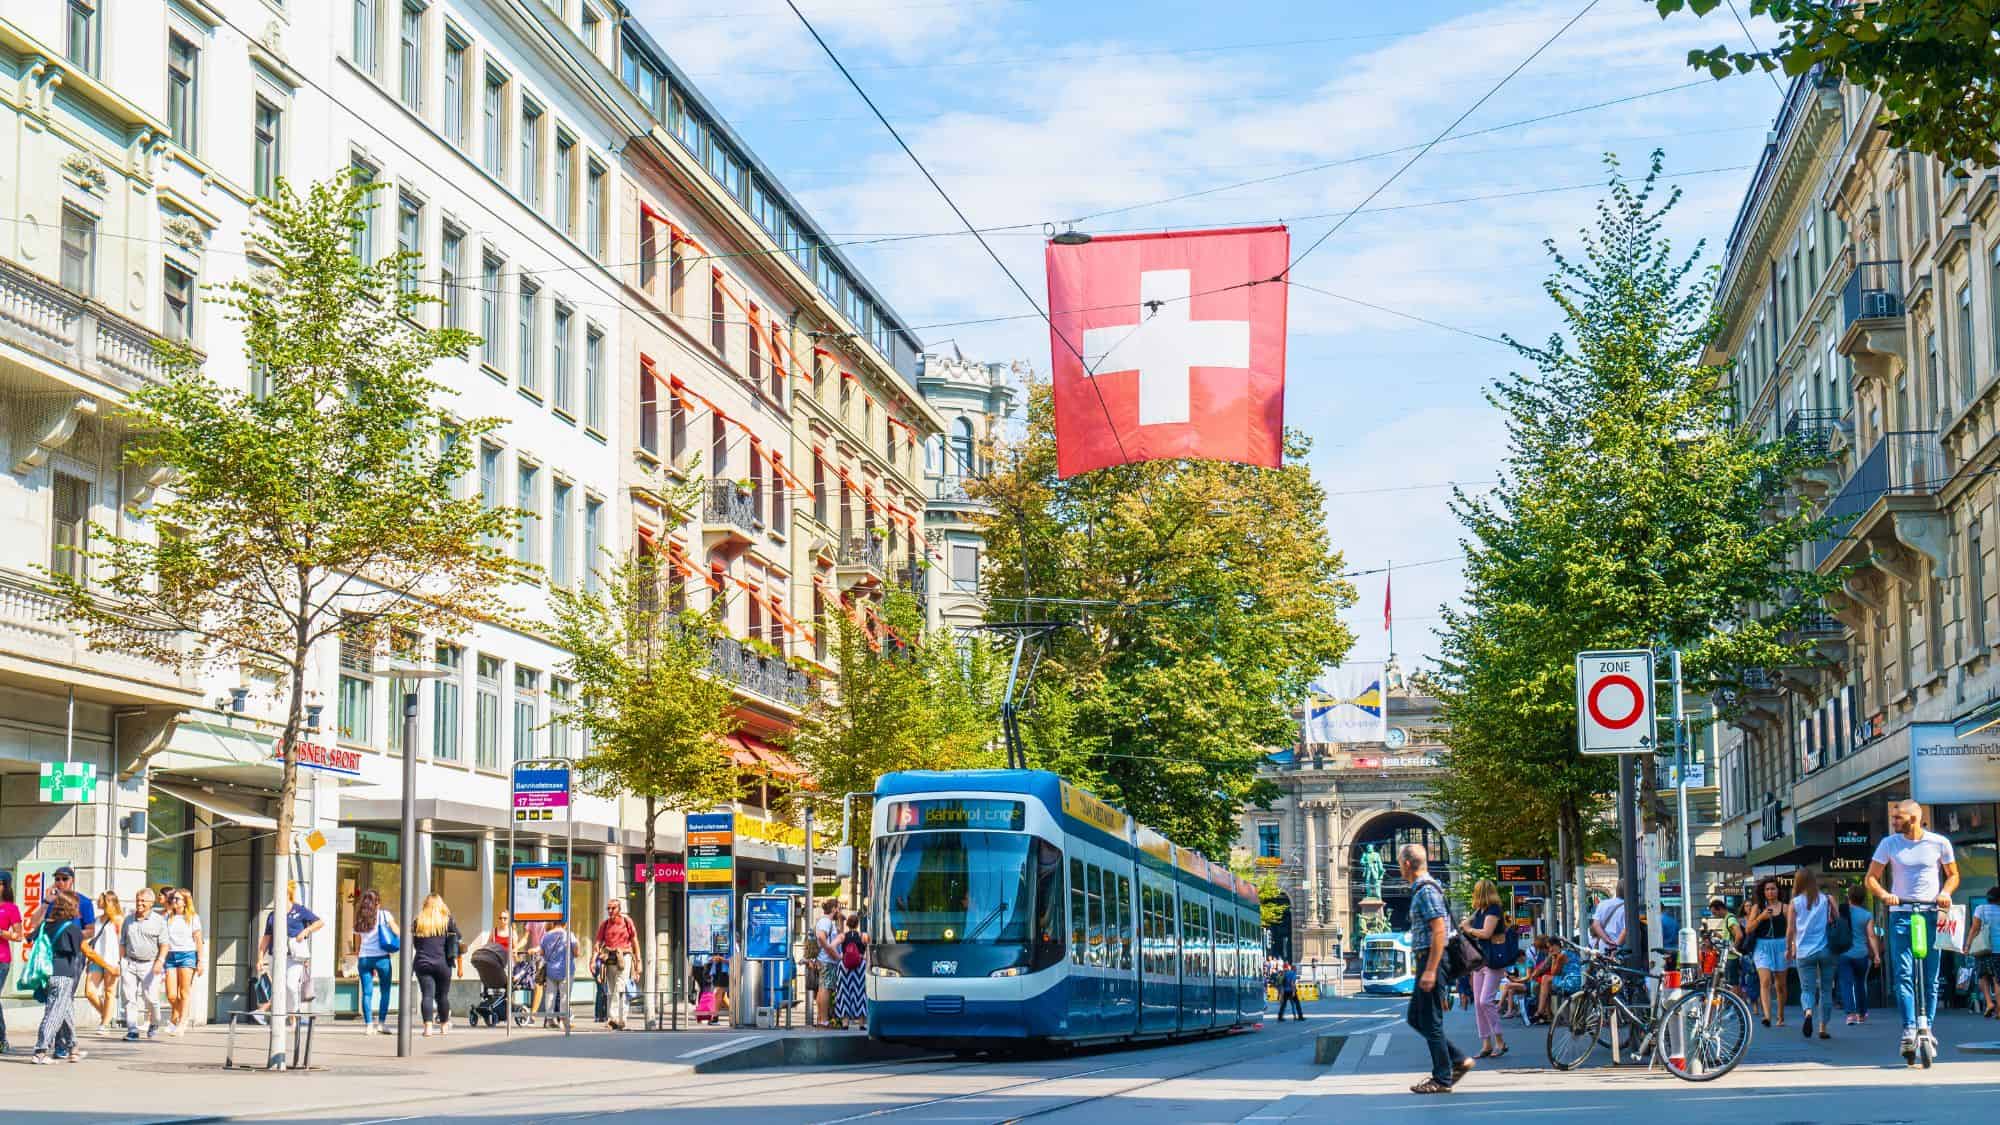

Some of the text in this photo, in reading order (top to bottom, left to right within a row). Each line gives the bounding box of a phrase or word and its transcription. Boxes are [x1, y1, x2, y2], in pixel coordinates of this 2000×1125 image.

[1600, 661, 1631, 673] ZONE
[329, 748, 362, 770] SPORT
[518, 798, 528, 806] 17
[901, 808, 913, 824] 6
[693, 849, 699, 857] 7
[1830, 857, 1865, 869] GÖTTE
